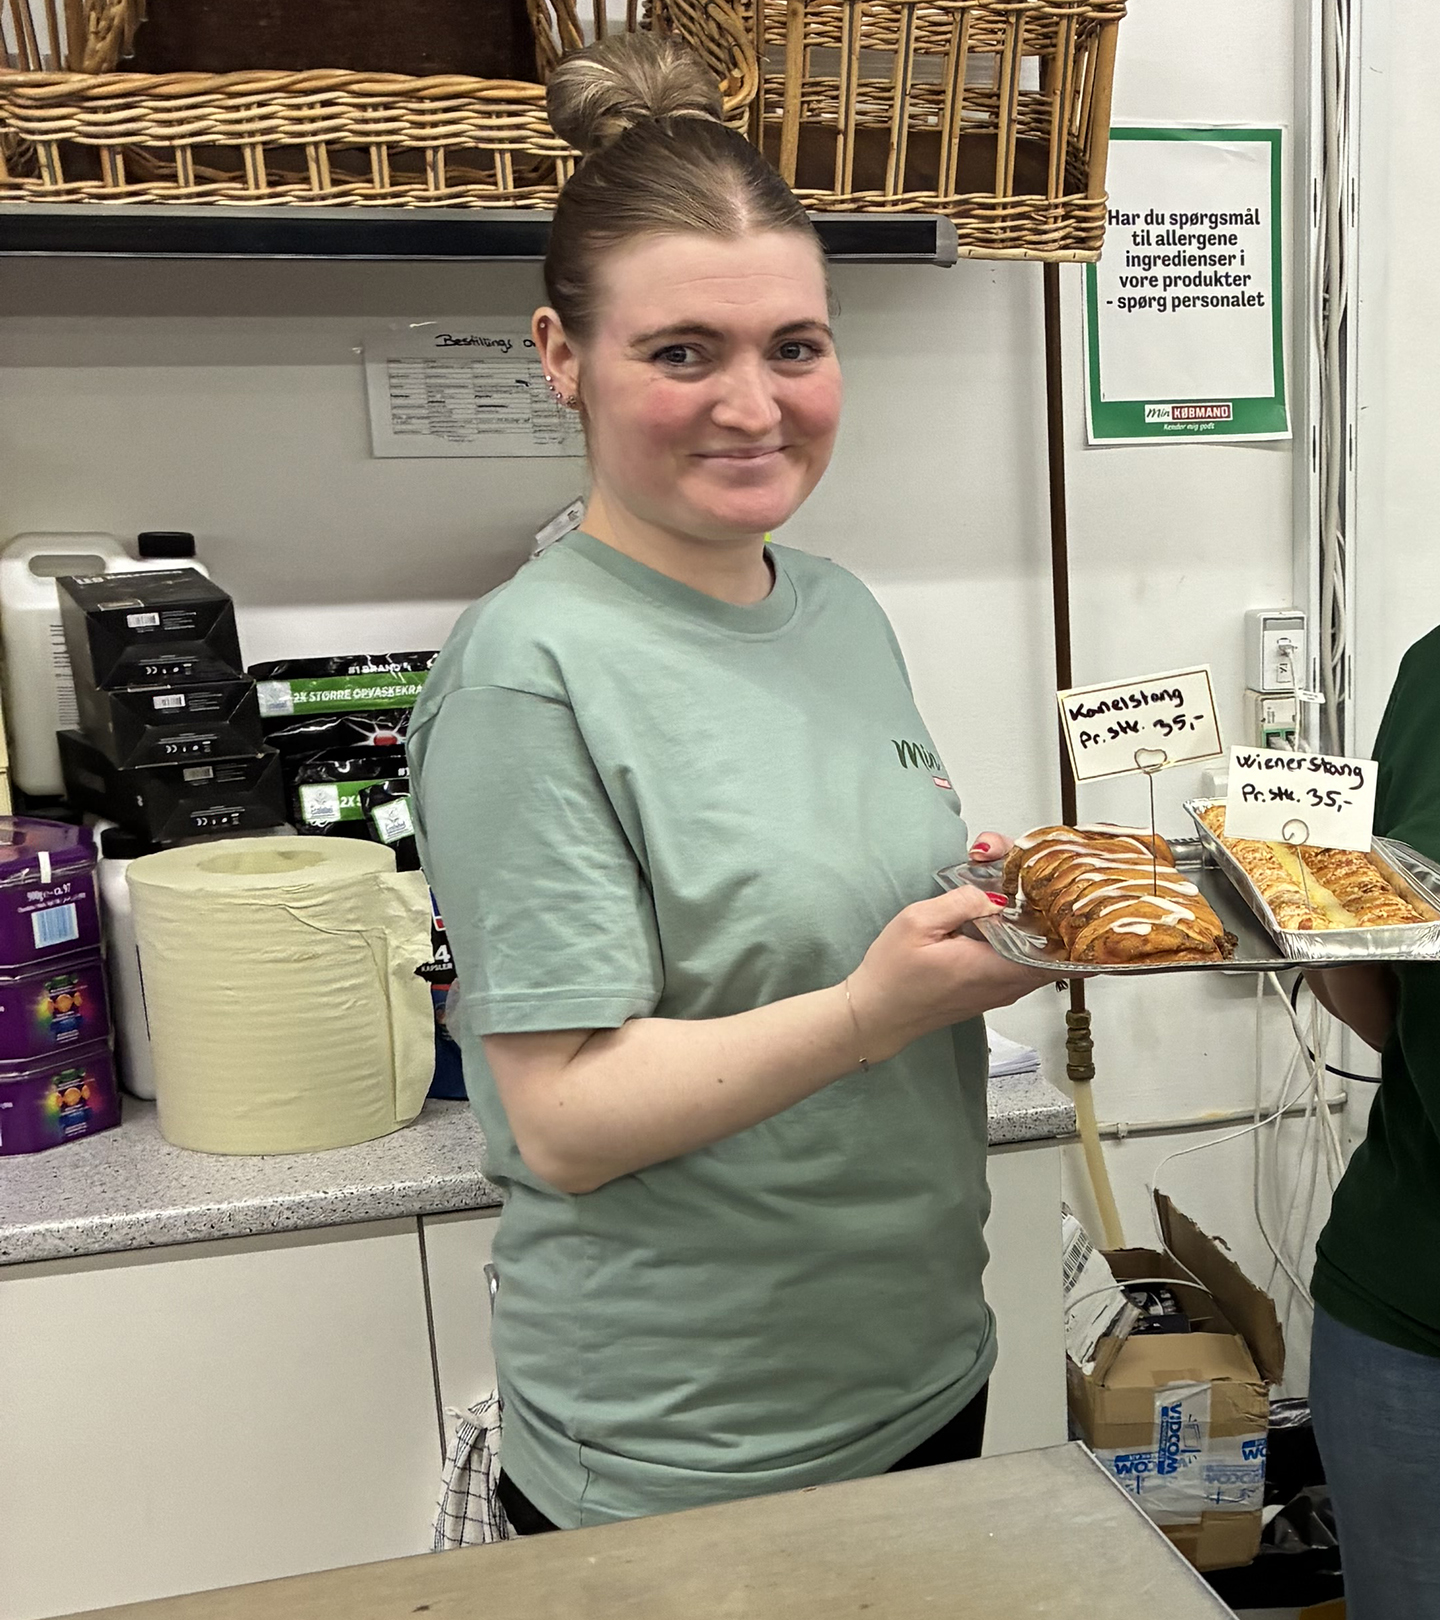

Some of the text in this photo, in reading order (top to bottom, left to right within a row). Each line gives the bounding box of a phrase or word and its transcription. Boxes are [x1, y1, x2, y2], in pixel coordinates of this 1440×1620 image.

[1108, 208, 1260, 229] Har du spørgsmål
[1132, 229, 1238, 250] til allergene
[1126, 250, 1245, 271] ingredienser i
[1119, 270, 1251, 291] vore produkter
[1117, 294, 1166, 313] spørg
[1172, 291, 1265, 312] personalet
[1146, 406, 1229, 419] Min KØBMAND
[309, 690, 351, 702] STØRRE
[353, 685, 423, 700] OPVASKEKRA
[1069, 687, 1184, 721] Kanelstang
[1153, 713, 1204, 738] 35,-
[891, 739, 941, 772] Min
[1306, 788, 1353, 812] 35,-
[1165, 1402, 1182, 1475] VIDCOM
